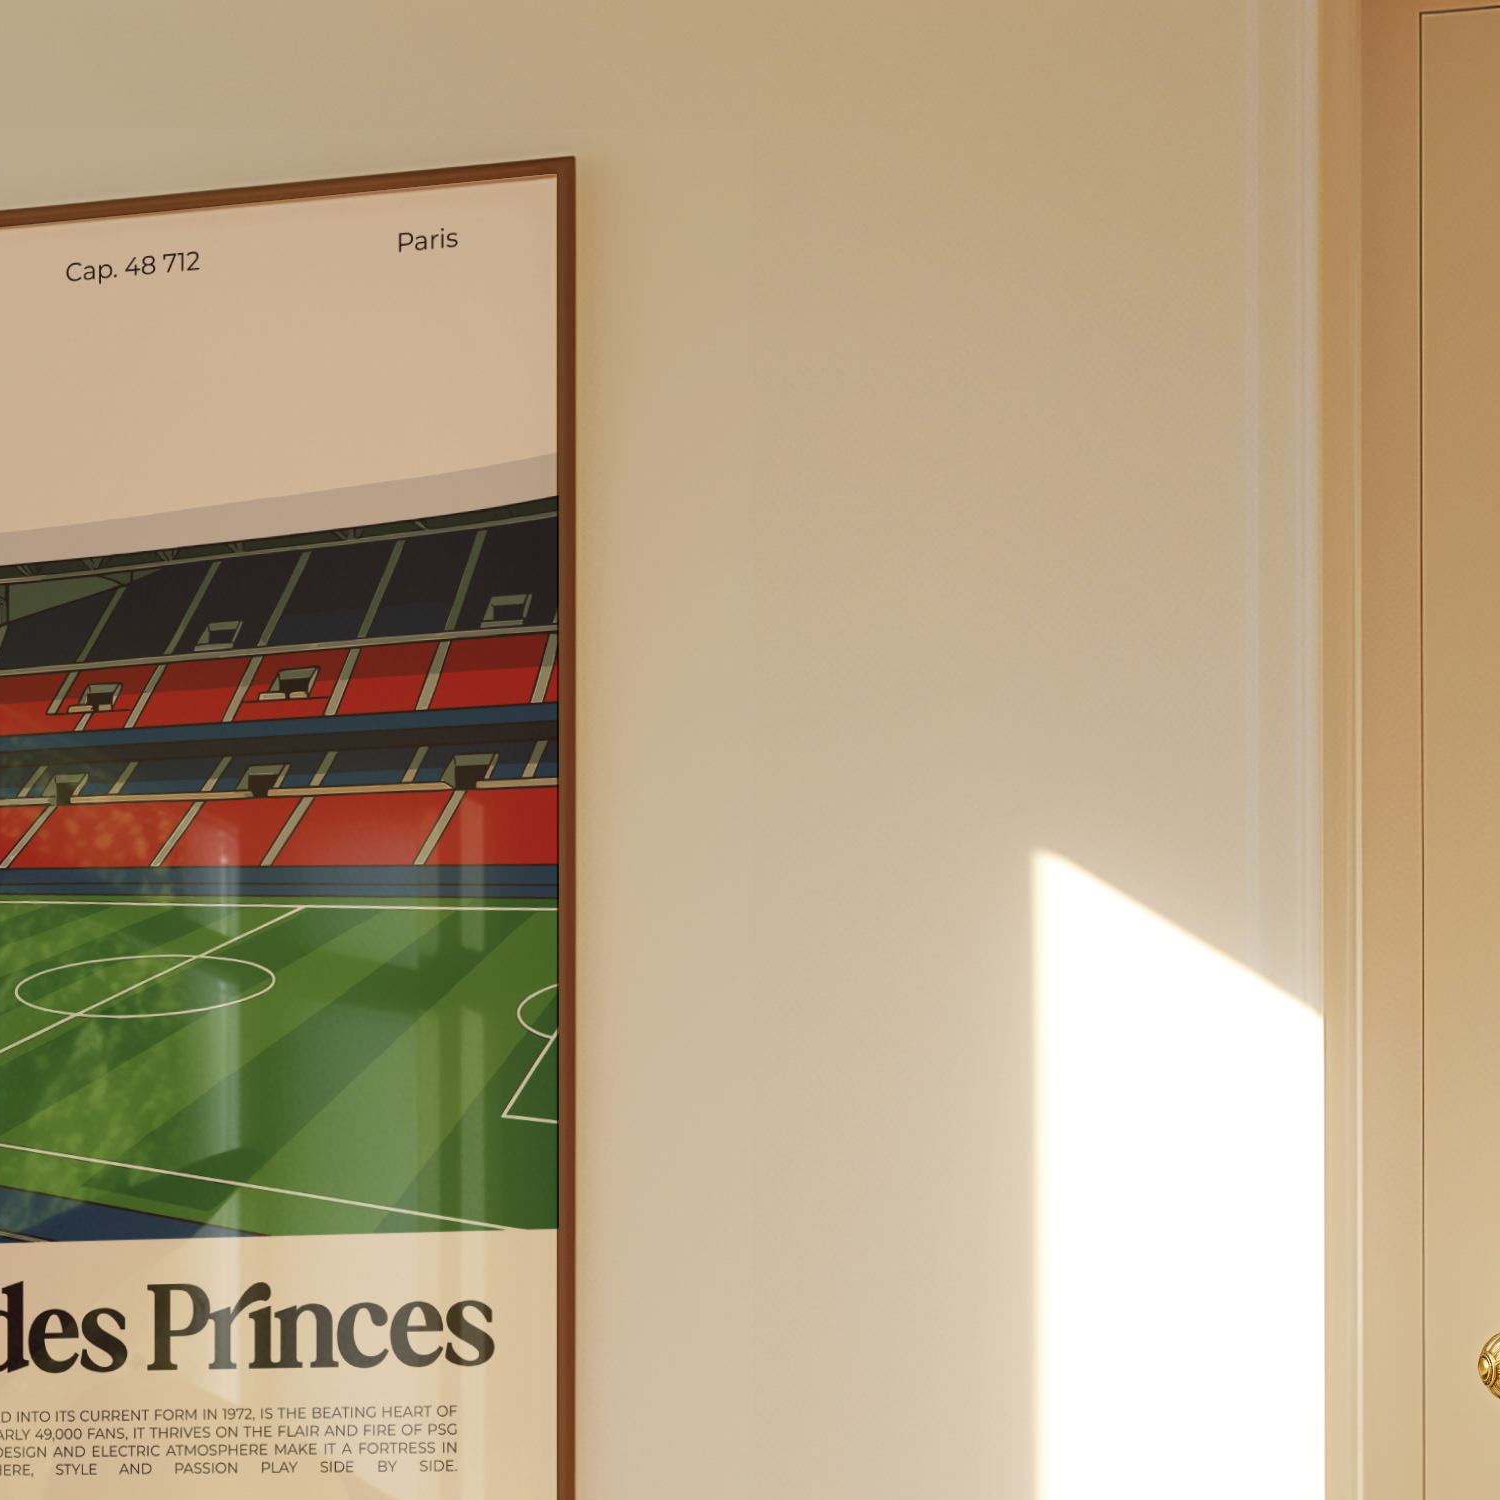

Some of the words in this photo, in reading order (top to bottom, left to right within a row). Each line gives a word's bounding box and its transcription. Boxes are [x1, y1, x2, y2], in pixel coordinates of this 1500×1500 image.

[398, 227, 459, 253] Paris
[65, 261, 118, 285] Cap.
[124, 254, 156, 277] 48
[162, 250, 201, 274] 712
[146, 1281, 496, 1371] Princes
[16, 1410, 51, 1423] INTO
[55, 1409, 76, 1423] ITS
[79, 1408, 150, 1423] CURRENT
[154, 1408, 198, 1422] FORM
[202, 1408, 218, 1421] IN
[221, 1407, 256, 1422] 1972,
[260, 1407, 274, 1420] IS
[276, 1406, 307, 1420] THE
[311, 1405, 377, 1420] BEATING
[381, 1404, 433, 1419] HEART
[436, 1404, 458, 1418] OF
[34, 1427, 83, 1443] 49,000
[87, 1426, 129, 1442] FANS,
[133, 1426, 146, 1440] IT
[148, 1425, 212, 1440] THRIVES
[215, 1425, 239, 1439] ON
[242, 1425, 273, 1438] THE
[277, 1424, 320, 1438] FLAIR
[323, 1424, 359, 1437] AND
[363, 1423, 397, 1437] FIRE
[401, 1423, 423, 1437] OF
[427, 1422, 458, 1436] PSG
[52, 1445, 86, 1458] AND
[92, 1444, 161, 1458] ELECTRIC
[165, 1443, 269, 1457] ATMOSPHERE
[274, 1442, 318, 1456] MAKE
[324, 1442, 337, 1455] IT
[341, 1442, 353, 1455] A
[358, 1441, 436, 1455] FORTRESS
[442, 1440, 458, 1454] IN
[55, 1462, 98, 1476] STYLE
[118, 1462, 153, 1476] AND
[174, 1461, 238, 1475] PASSION
[261, 1461, 299, 1474] PLAY
[319, 1460, 354, 1474] SIDE
[377, 1460, 398, 1473] BY
[419, 1459, 458, 1473] SIDE.
